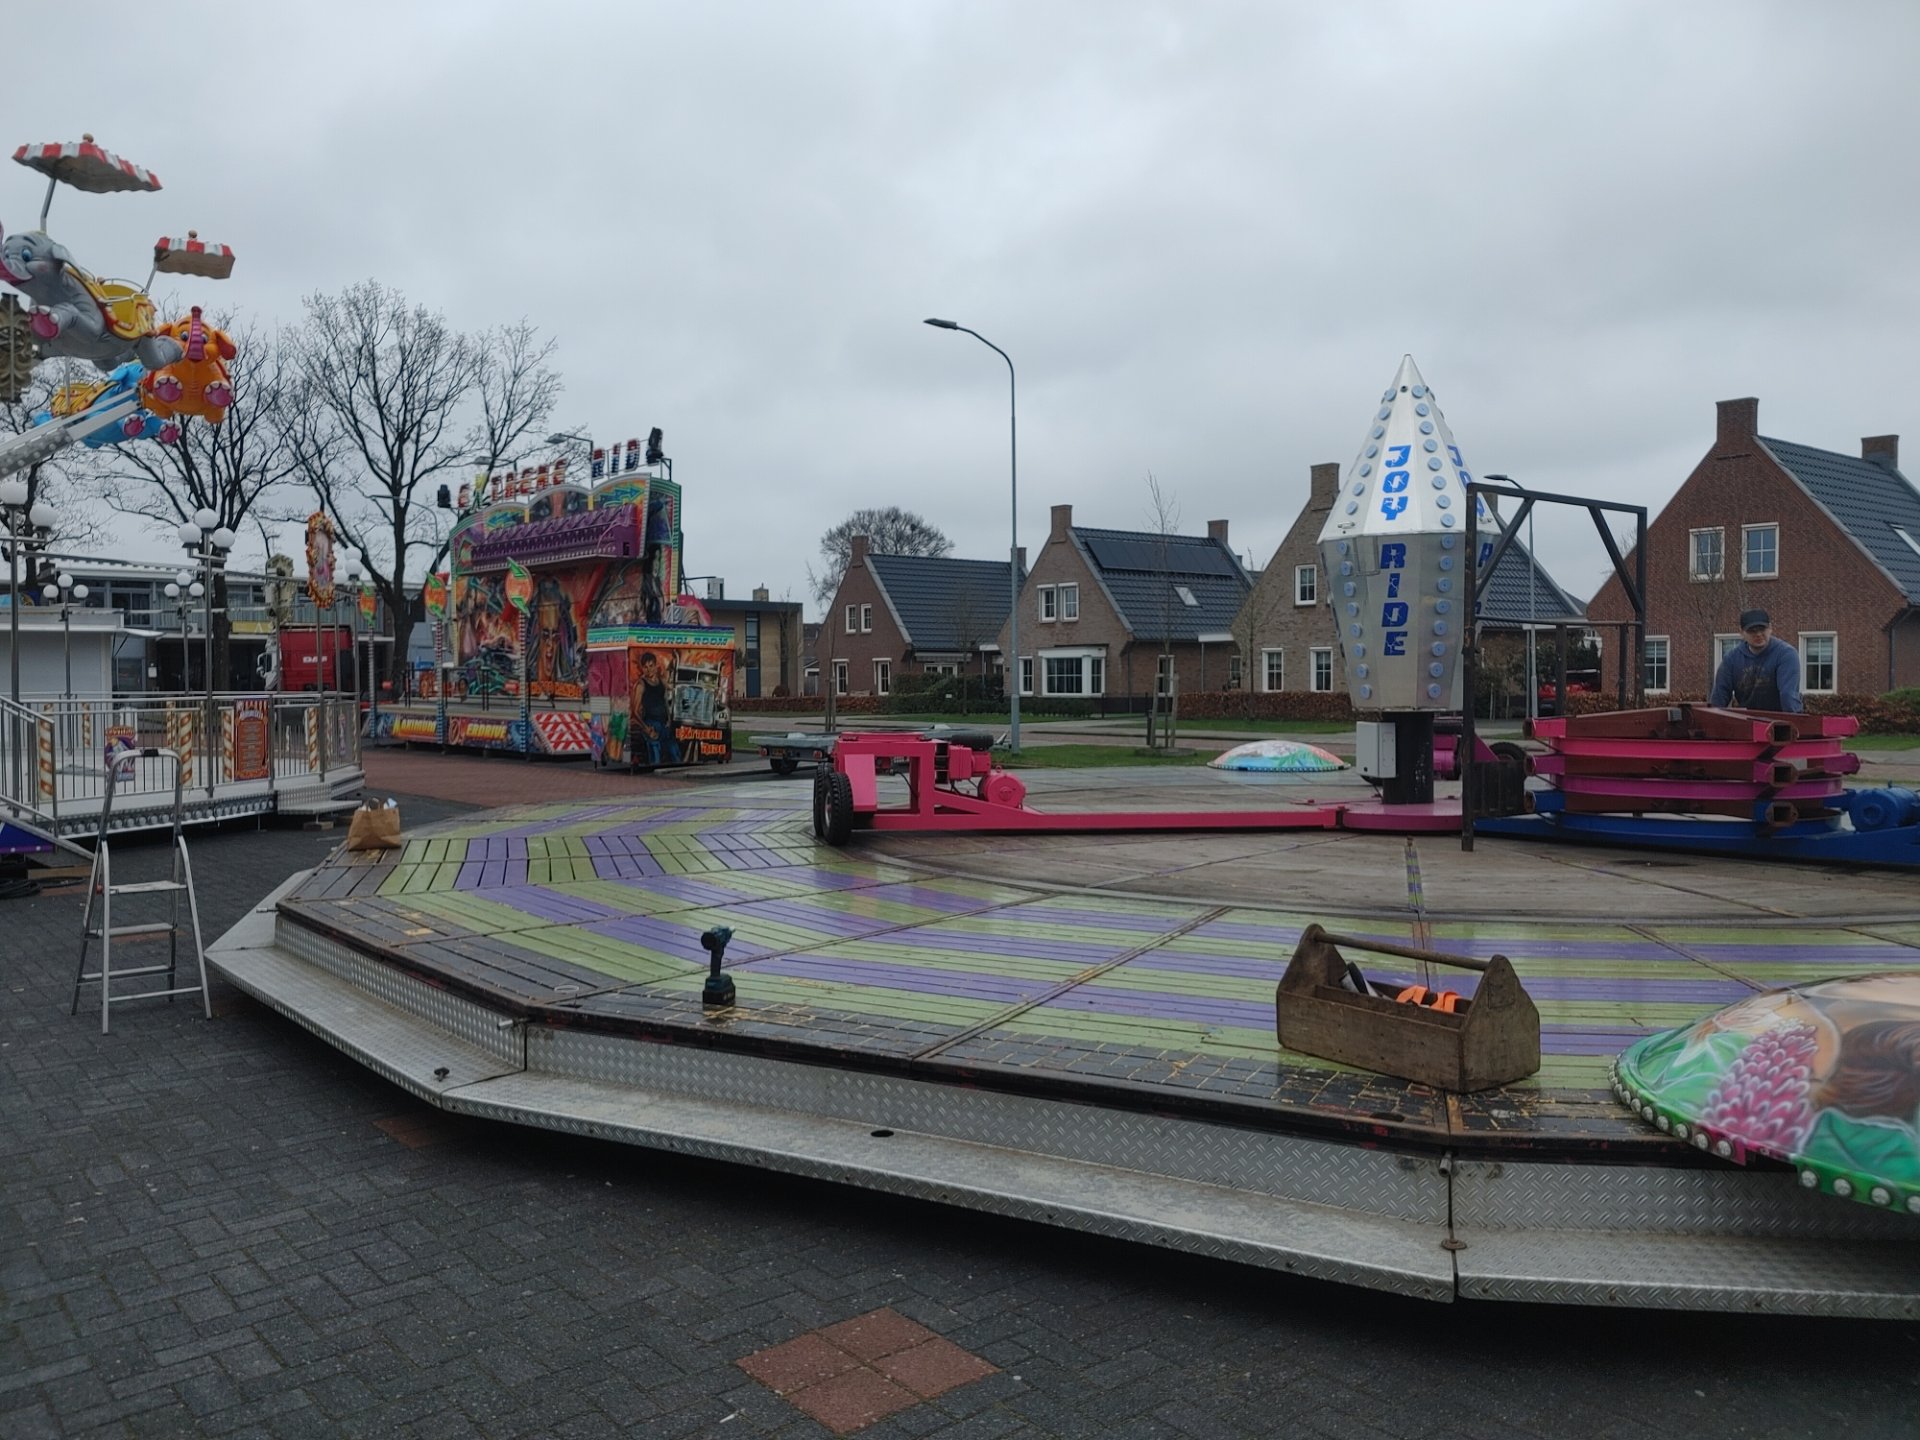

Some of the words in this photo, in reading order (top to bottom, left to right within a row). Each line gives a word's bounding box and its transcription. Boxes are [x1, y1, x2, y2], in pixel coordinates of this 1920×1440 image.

[591, 438, 641, 480] RID
[1380, 444, 1412, 521] JOY
[1380, 542, 1410, 656] RIDE
[302, 656, 328, 664] DAF
[636, 635, 689, 645] CONTROL
[692, 637, 729, 646] ROOM
